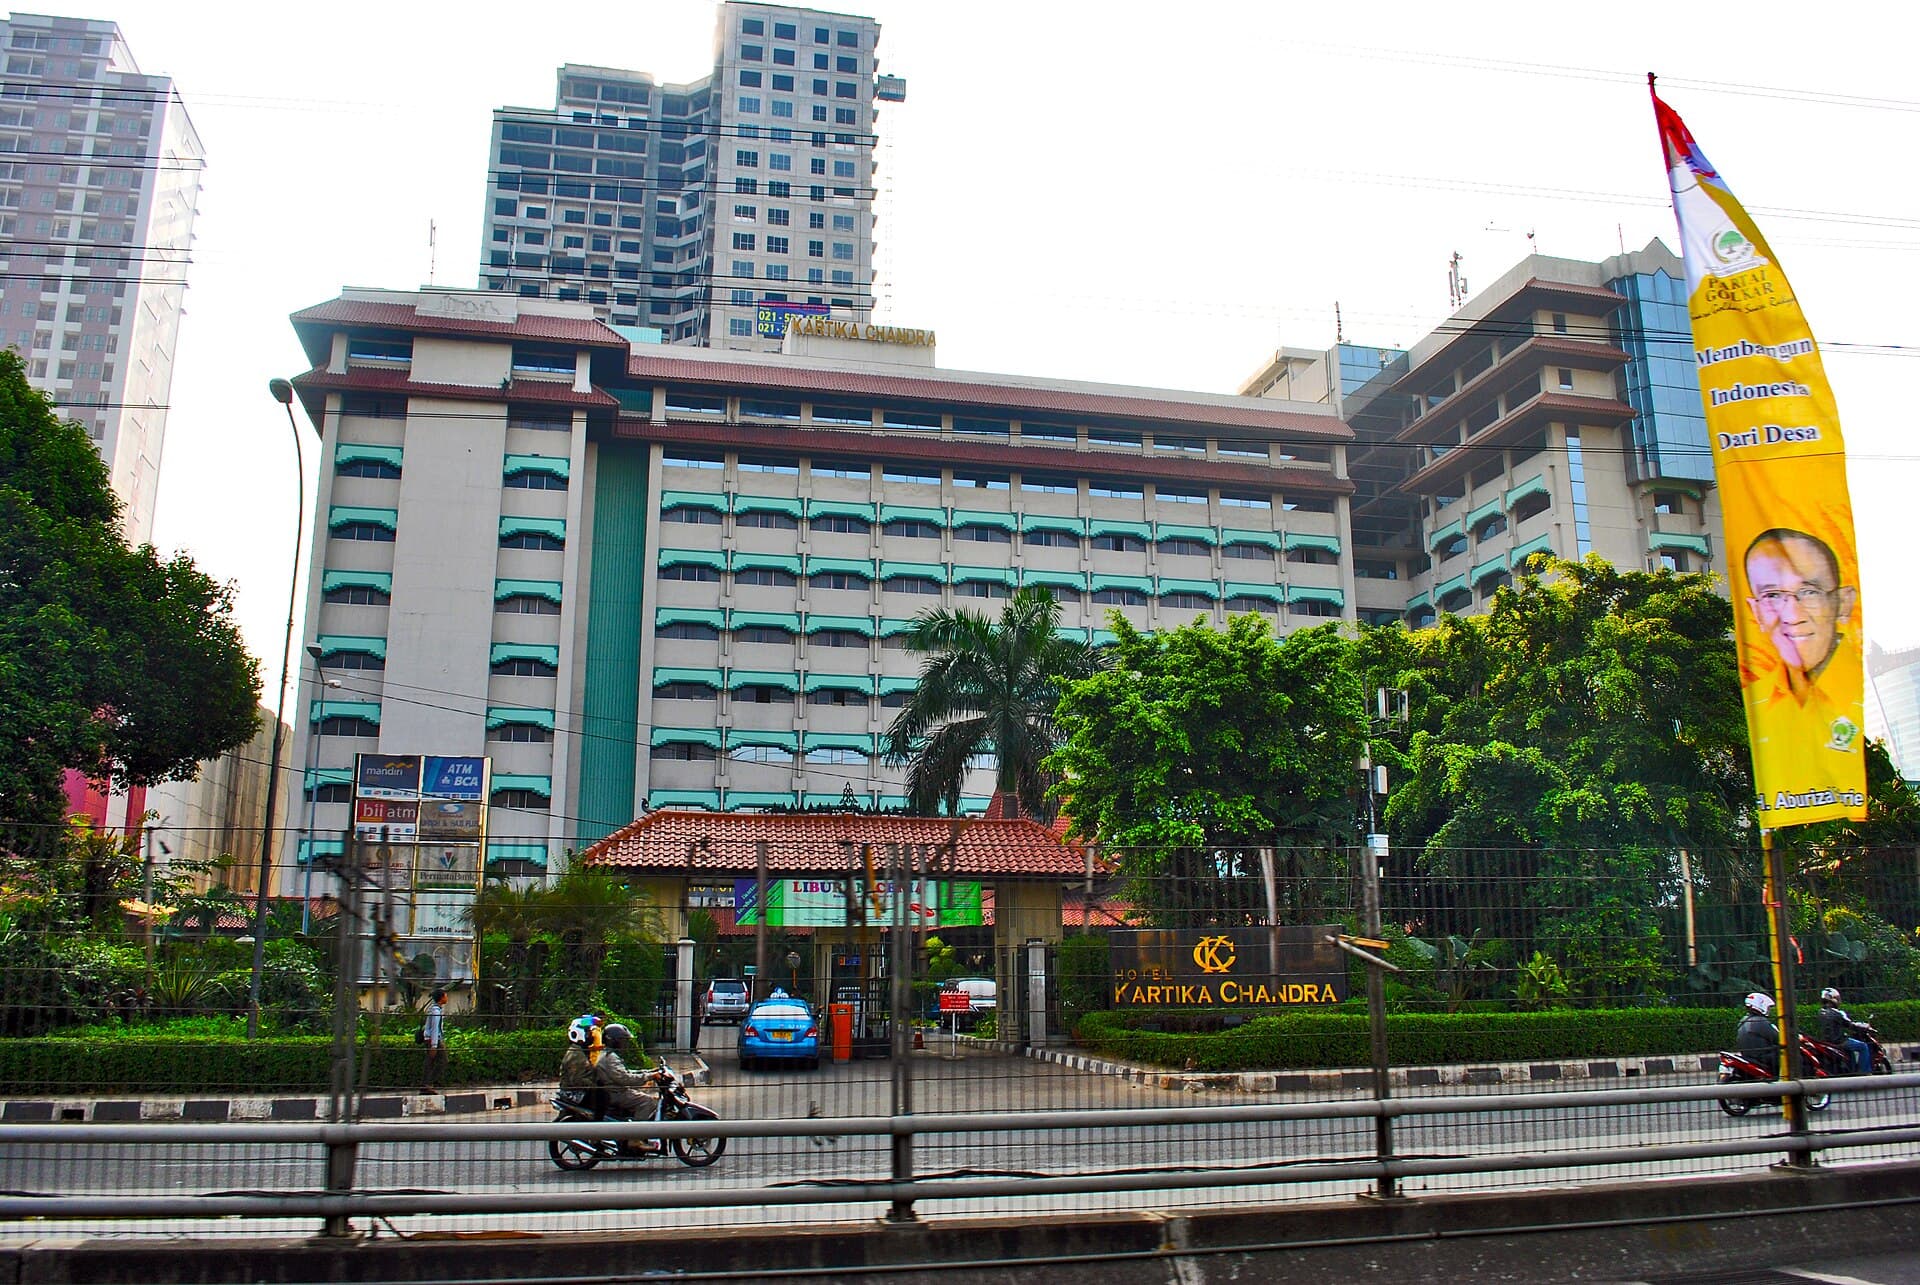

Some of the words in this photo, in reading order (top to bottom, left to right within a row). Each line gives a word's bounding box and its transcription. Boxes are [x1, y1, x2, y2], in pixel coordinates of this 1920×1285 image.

[1705, 282, 1774, 302] GOLKAR
[758, 311, 777, 321] 021
[758, 323, 775, 333] 021
[792, 318, 860, 341] KARTIKA
[865, 324, 937, 347] CHANDRA
[1697, 339, 1813, 365] Membangun
[1710, 381, 1809, 405] Indonesia
[1718, 428, 1758, 449] Dari
[1764, 425, 1817, 444] Desa
[366, 766, 403, 776] mandiri
[447, 764, 472, 774] ATM
[453, 776, 478, 786] BCA
[363, 803, 383, 817] bii
[386, 806, 416, 818] atm
[1114, 968, 1173, 981] HOTEL
[1114, 982, 1213, 1004] KARTIKA
[1219, 980, 1338, 1004] CHANDRA
